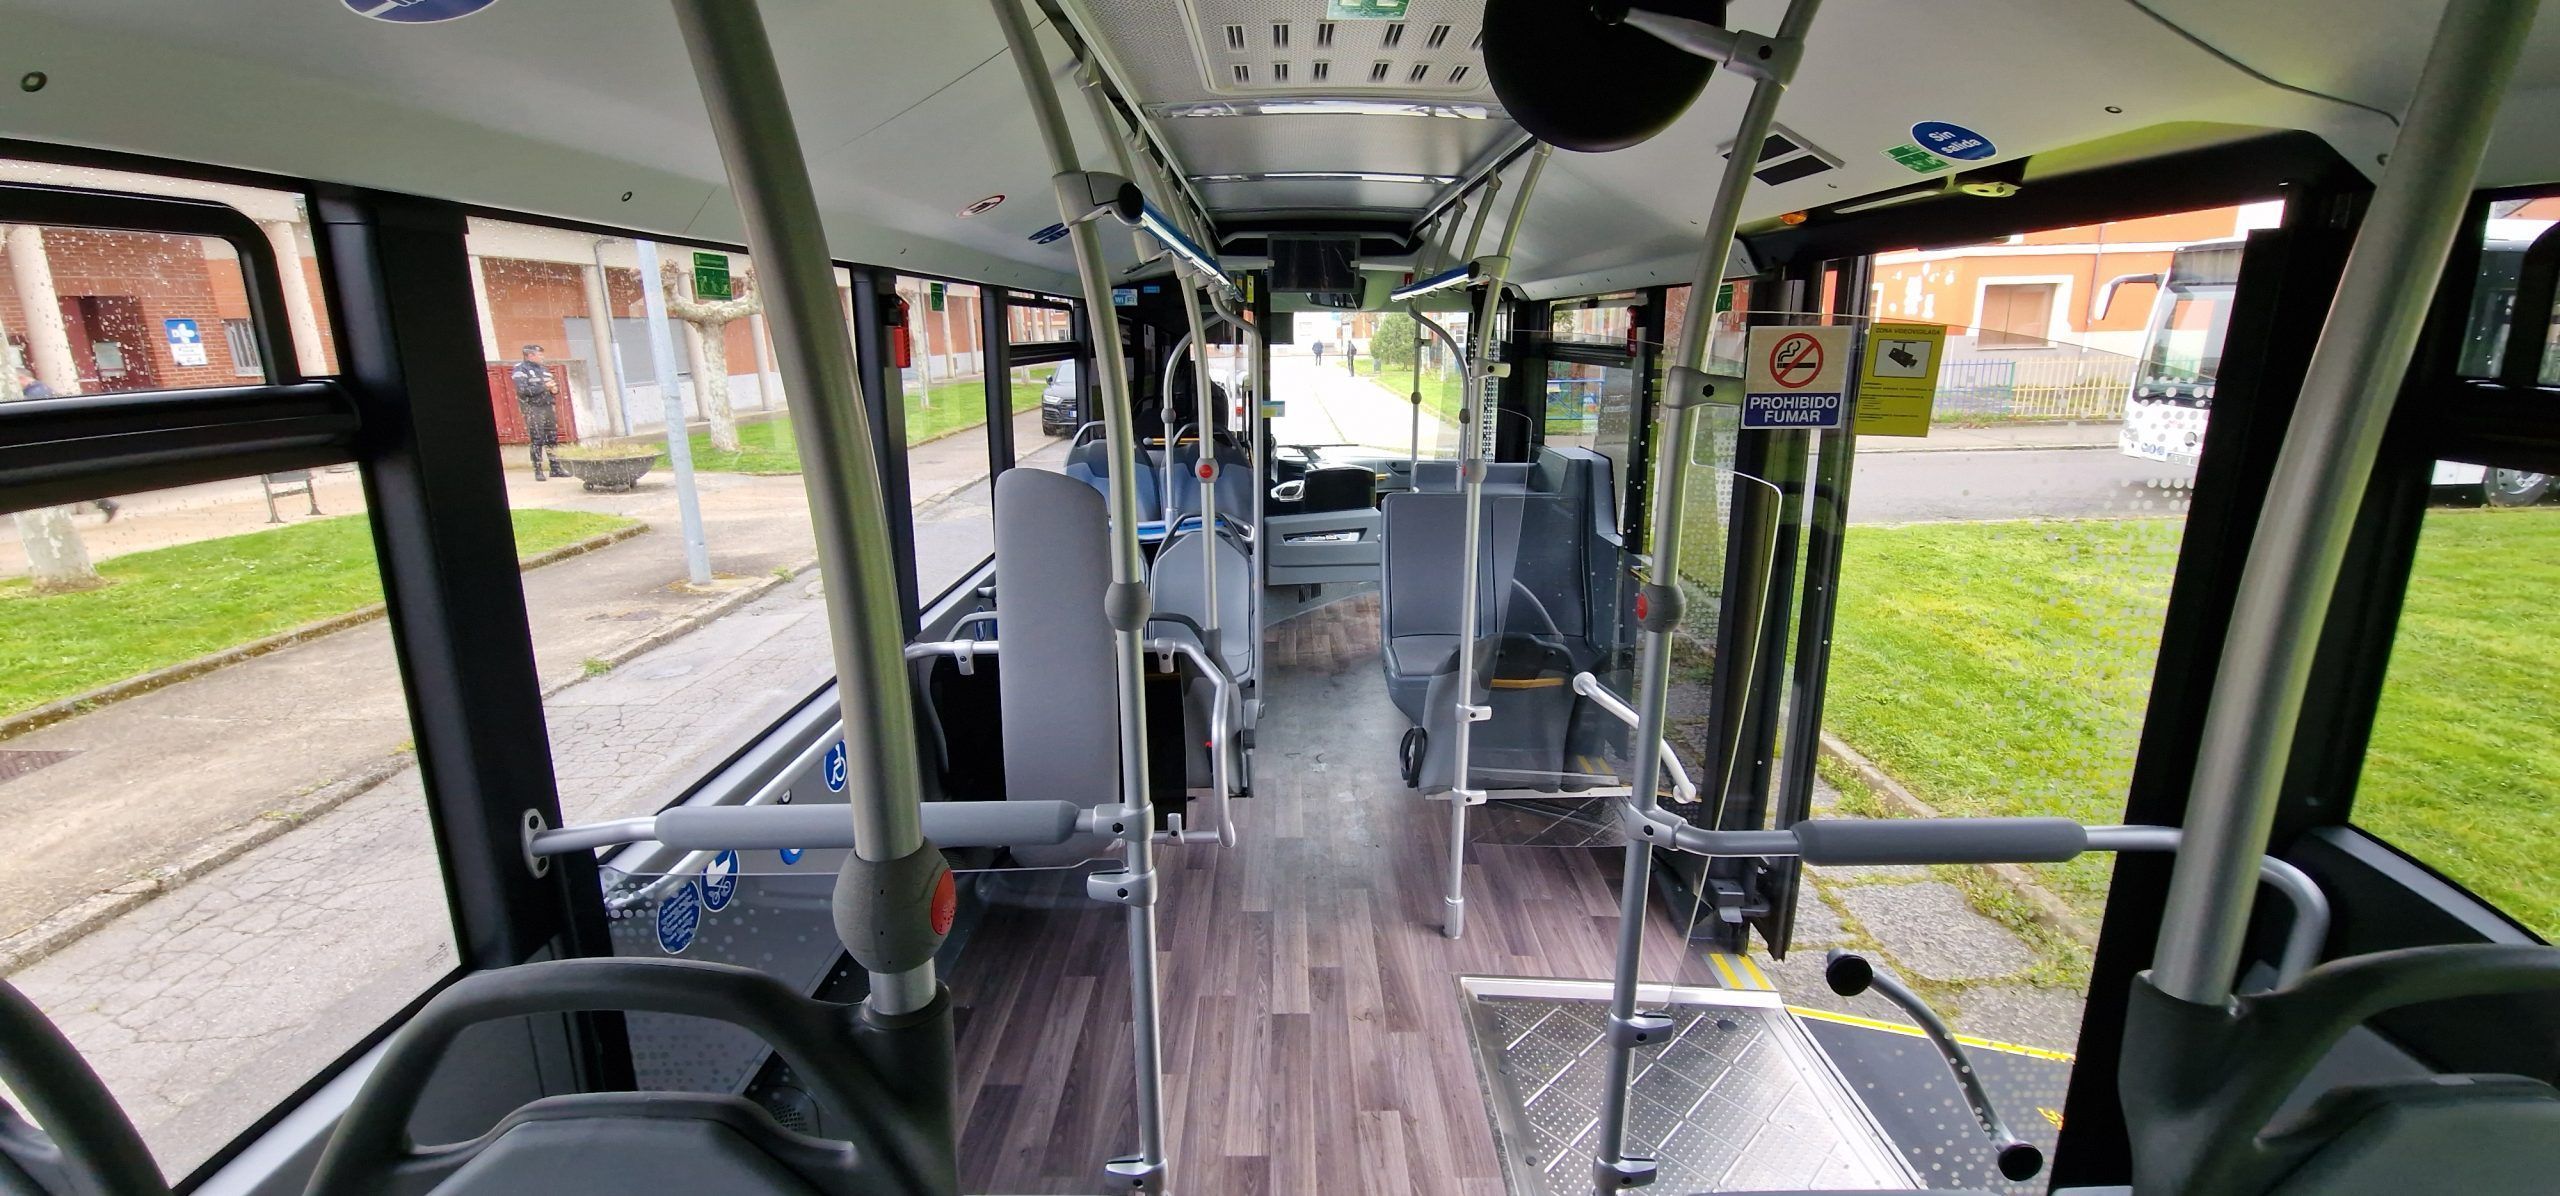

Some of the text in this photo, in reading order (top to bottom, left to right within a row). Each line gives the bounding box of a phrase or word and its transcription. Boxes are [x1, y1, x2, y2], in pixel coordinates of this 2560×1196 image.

[1929, 131, 1956, 142] Sin
[1940, 138, 1983, 154] salida
[1894, 327, 1940, 335] VIDEOVIGILADA
[1750, 396, 1837, 410] PROHIBIDO
[1764, 410, 1821, 423] FUMAR
